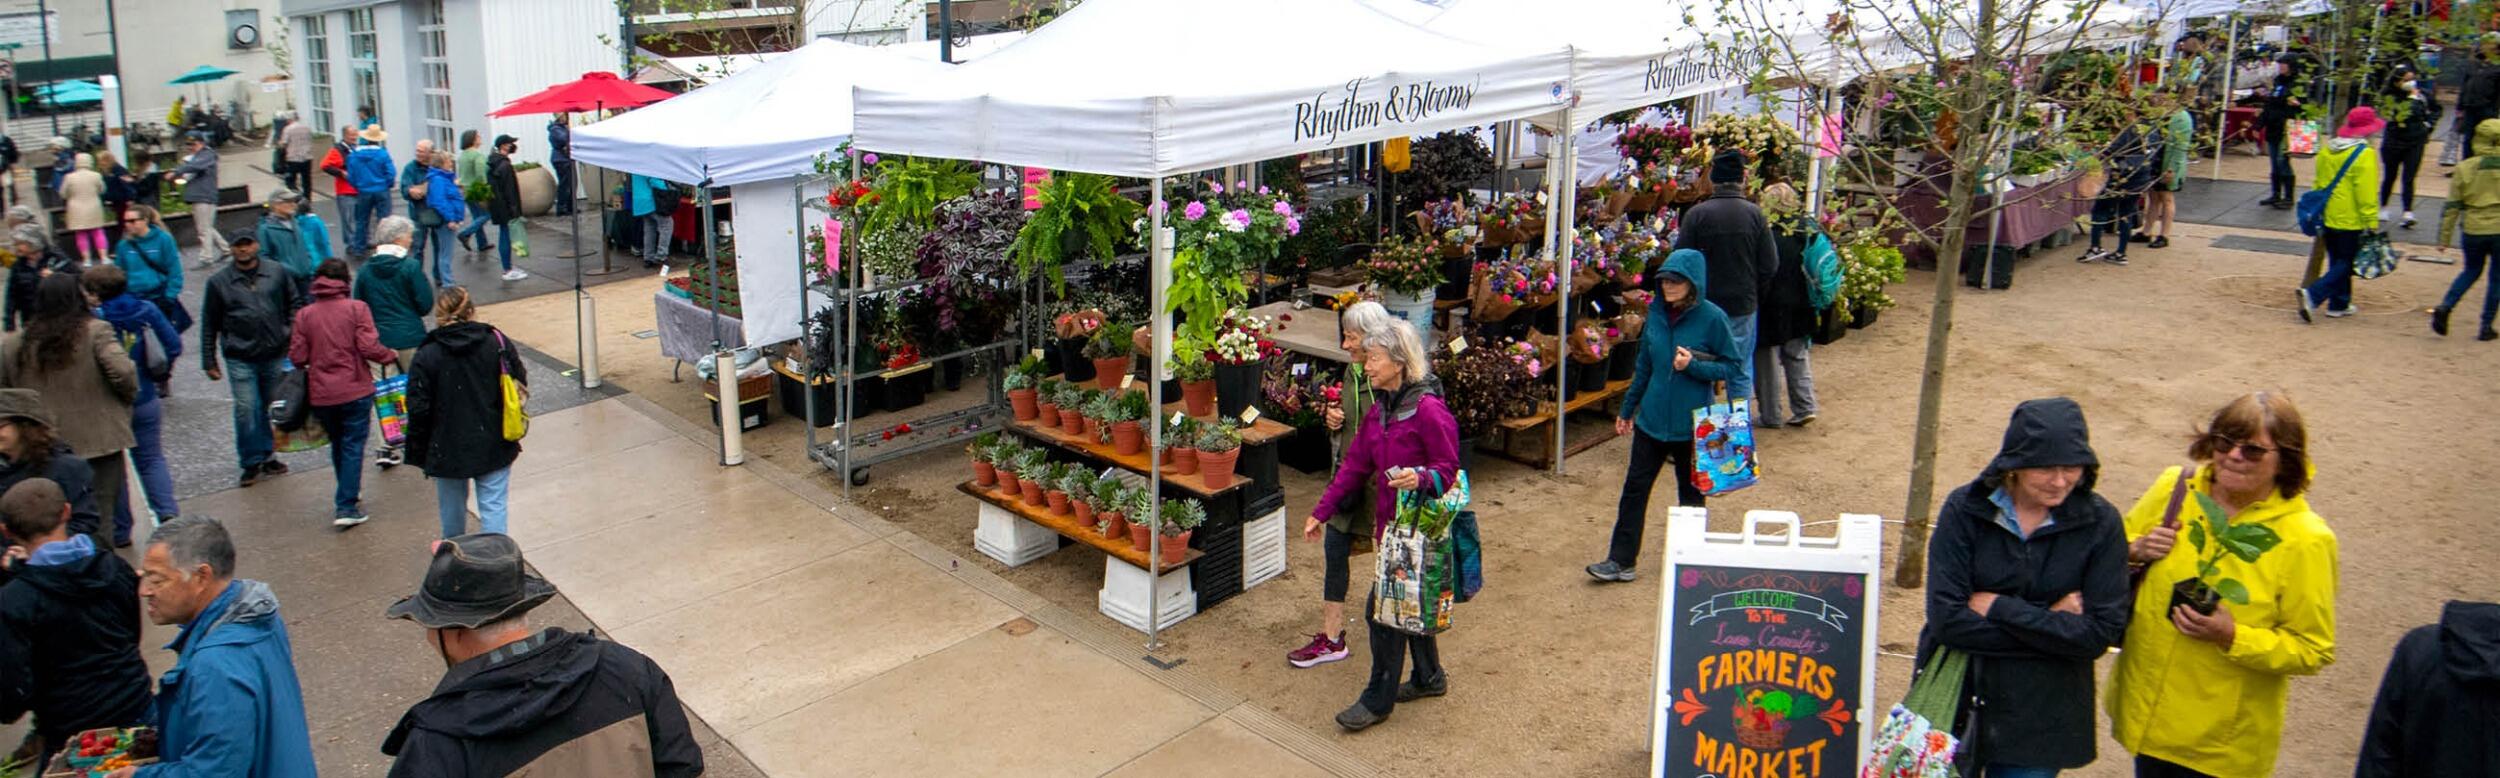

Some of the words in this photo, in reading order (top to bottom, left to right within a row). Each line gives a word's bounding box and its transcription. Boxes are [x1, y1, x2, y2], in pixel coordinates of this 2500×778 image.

[1644, 41, 1706, 97] Rhythm
[1709, 48, 1724, 81] &
[1294, 75, 1380, 146] Rhythm
[1385, 85, 1404, 123] &
[1407, 72, 1480, 122] Blooms
[1734, 591, 1796, 609] WELCOME
[1710, 621, 1750, 646] Lane
[1698, 649, 1836, 700] FARMERS
[1694, 730, 1828, 778] MARKET
